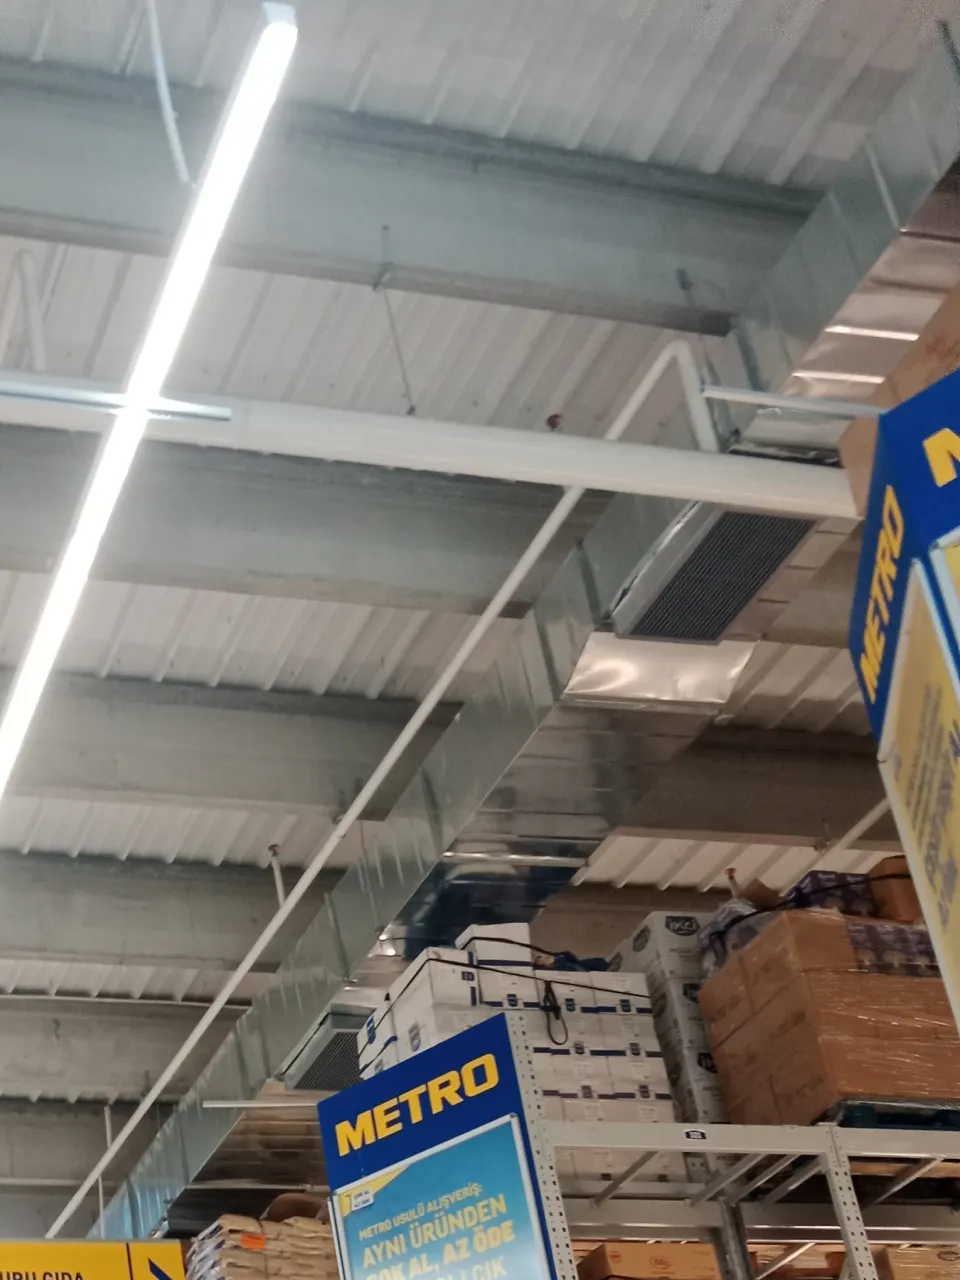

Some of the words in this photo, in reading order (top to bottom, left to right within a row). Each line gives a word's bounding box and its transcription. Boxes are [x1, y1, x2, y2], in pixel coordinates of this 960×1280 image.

[859, 484, 904, 703] METRO
[336, 1053, 499, 1157] METRO
[359, 1220, 391, 1240] METRO
[393, 1203, 425, 1227] USULÜ
[363, 1234, 407, 1269] AYNI
[409, 1193, 507, 1249] ÜRÜNDEN
[443, 1237, 471, 1265] AZ
[473, 1219, 516, 1253] ÖDE
